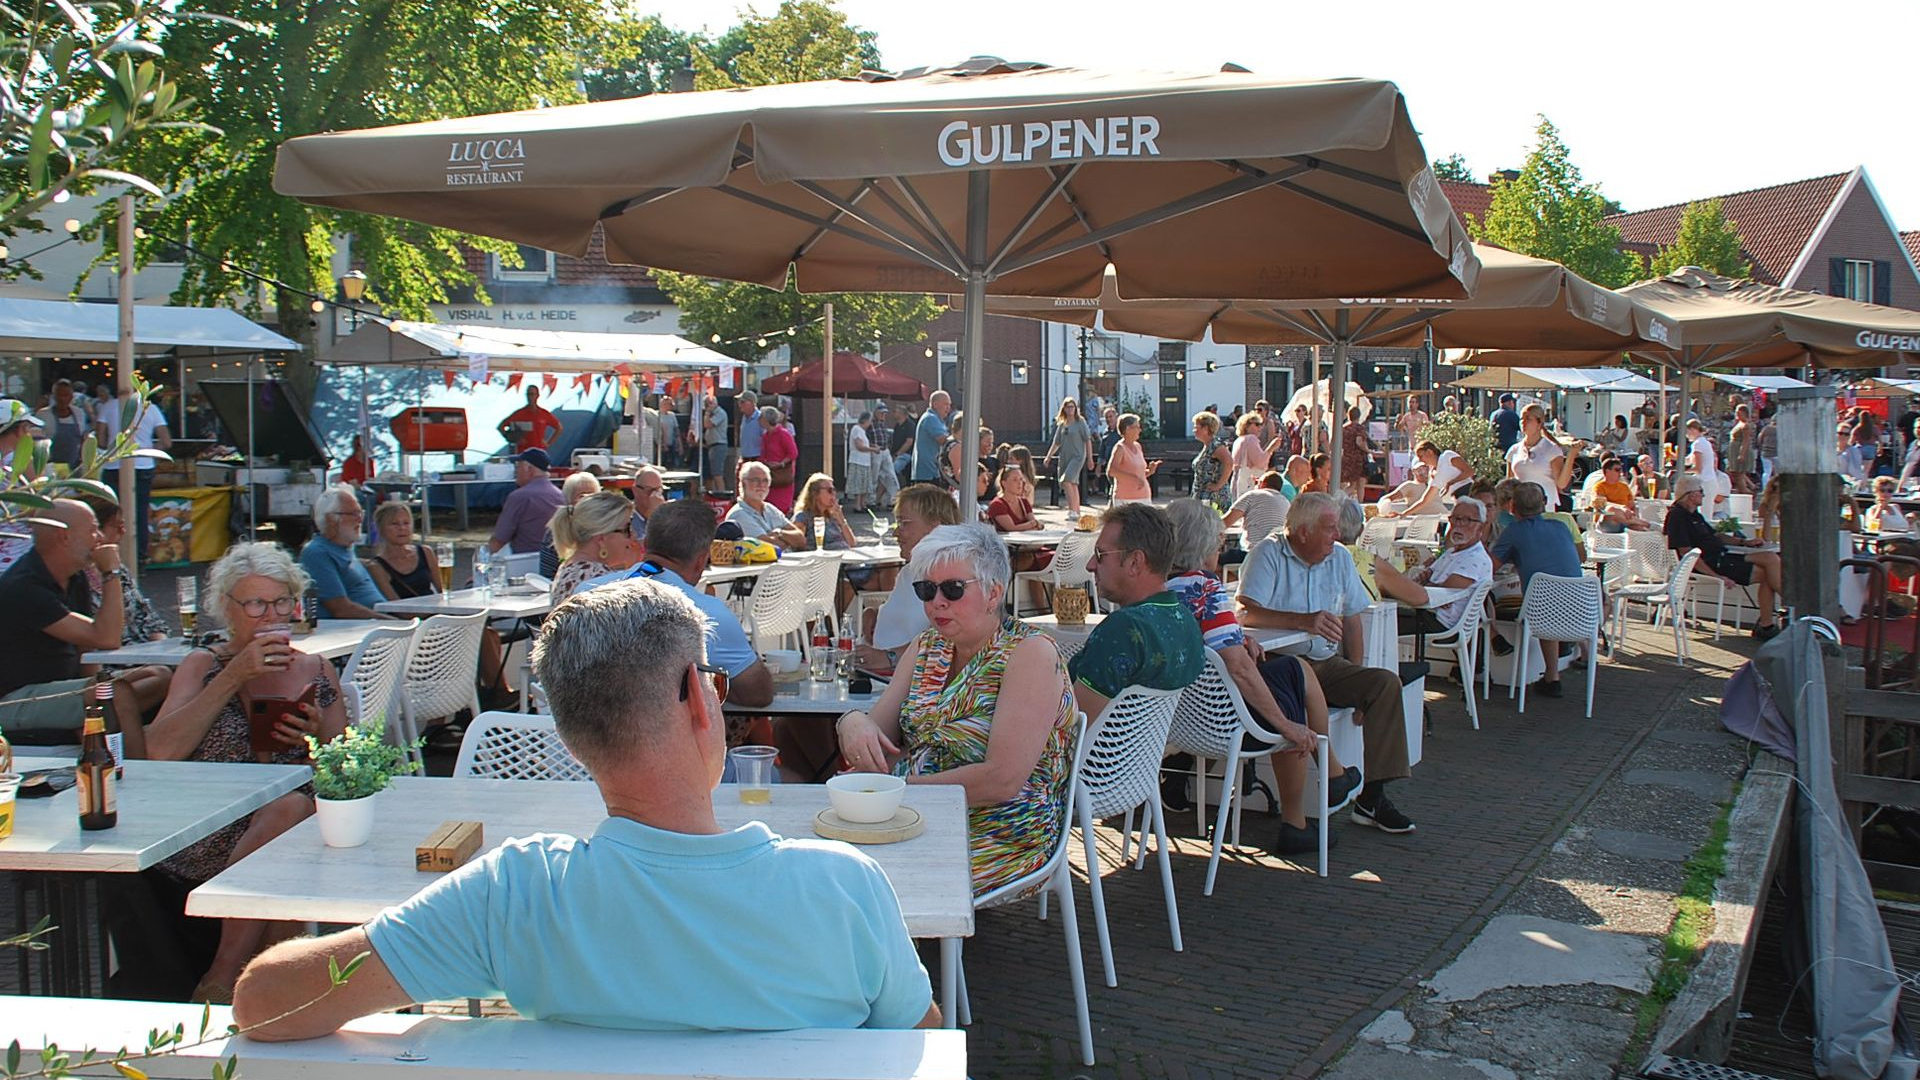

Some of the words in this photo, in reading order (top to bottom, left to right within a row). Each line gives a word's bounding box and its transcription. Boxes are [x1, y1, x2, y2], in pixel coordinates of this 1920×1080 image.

[447, 138, 526, 162] LUCCA
[937, 115, 1161, 167] GULPENER
[446, 171, 524, 186] RESTAURANT
[448, 310, 493, 320] VISHAL
[541, 310, 577, 320] HEIDE
